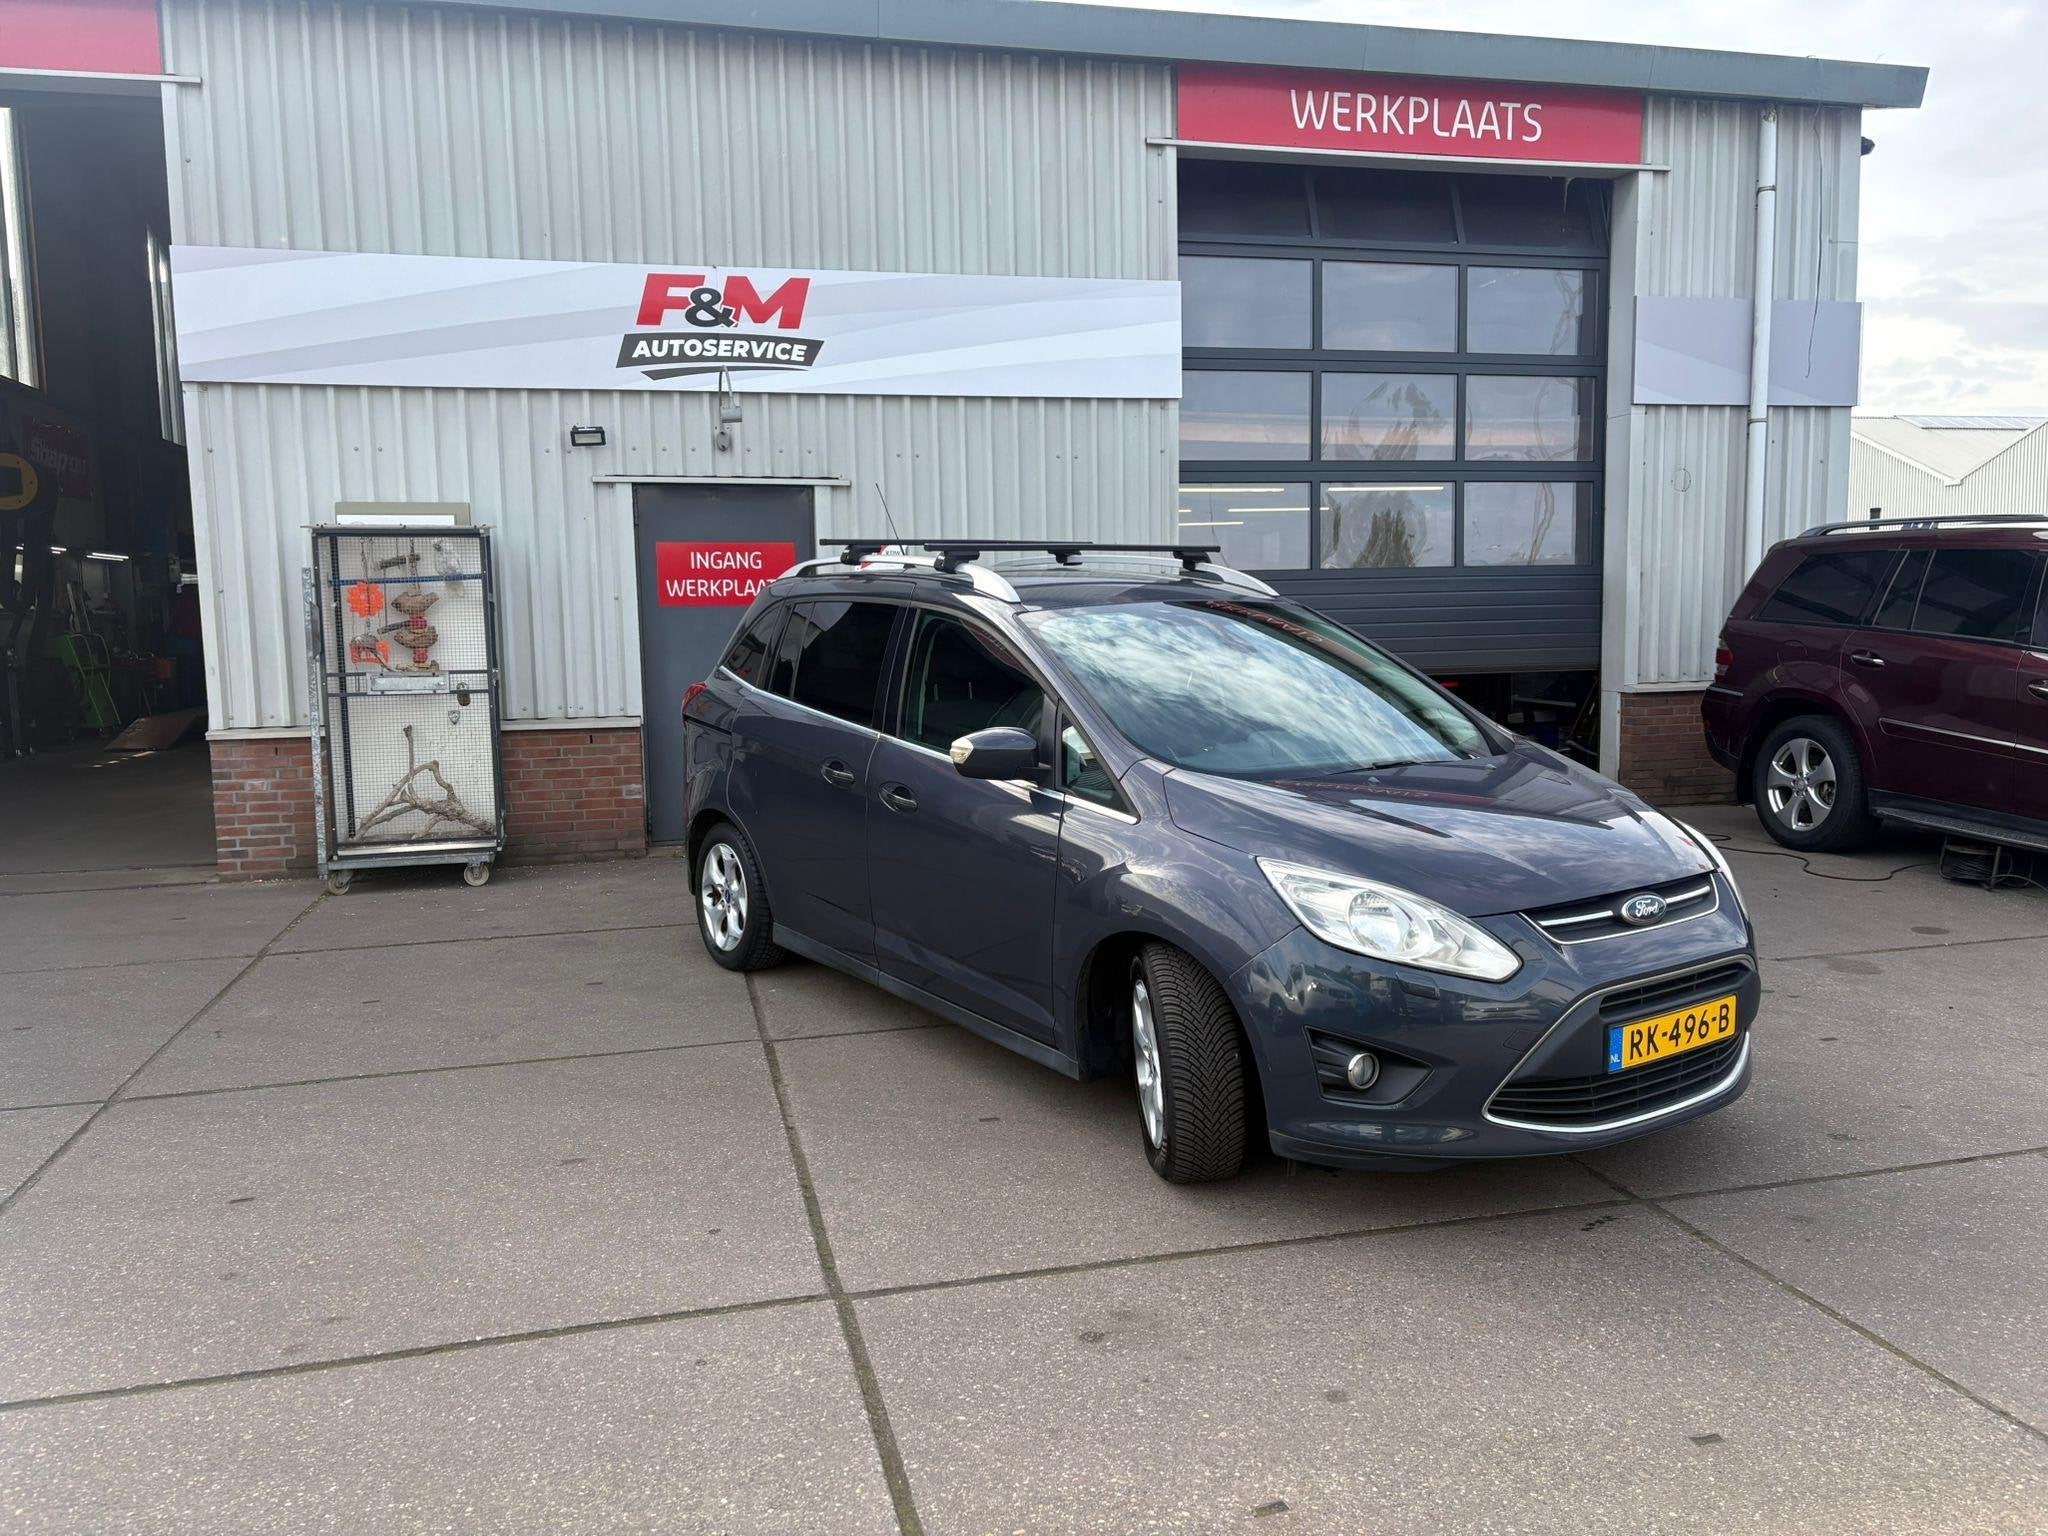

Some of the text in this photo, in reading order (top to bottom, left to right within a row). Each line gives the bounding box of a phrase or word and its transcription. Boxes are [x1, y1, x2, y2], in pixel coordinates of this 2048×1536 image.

[1290, 89, 1542, 142] WERKPLAATS
[636, 273, 811, 330] F&M
[632, 338, 807, 362] AUTOSERVICE
[690, 551, 762, 570] INGANG
[1635, 899, 1659, 917] Ford
[1630, 1003, 1730, 1060] RK-496-B
[1610, 1053, 1621, 1064] NL
